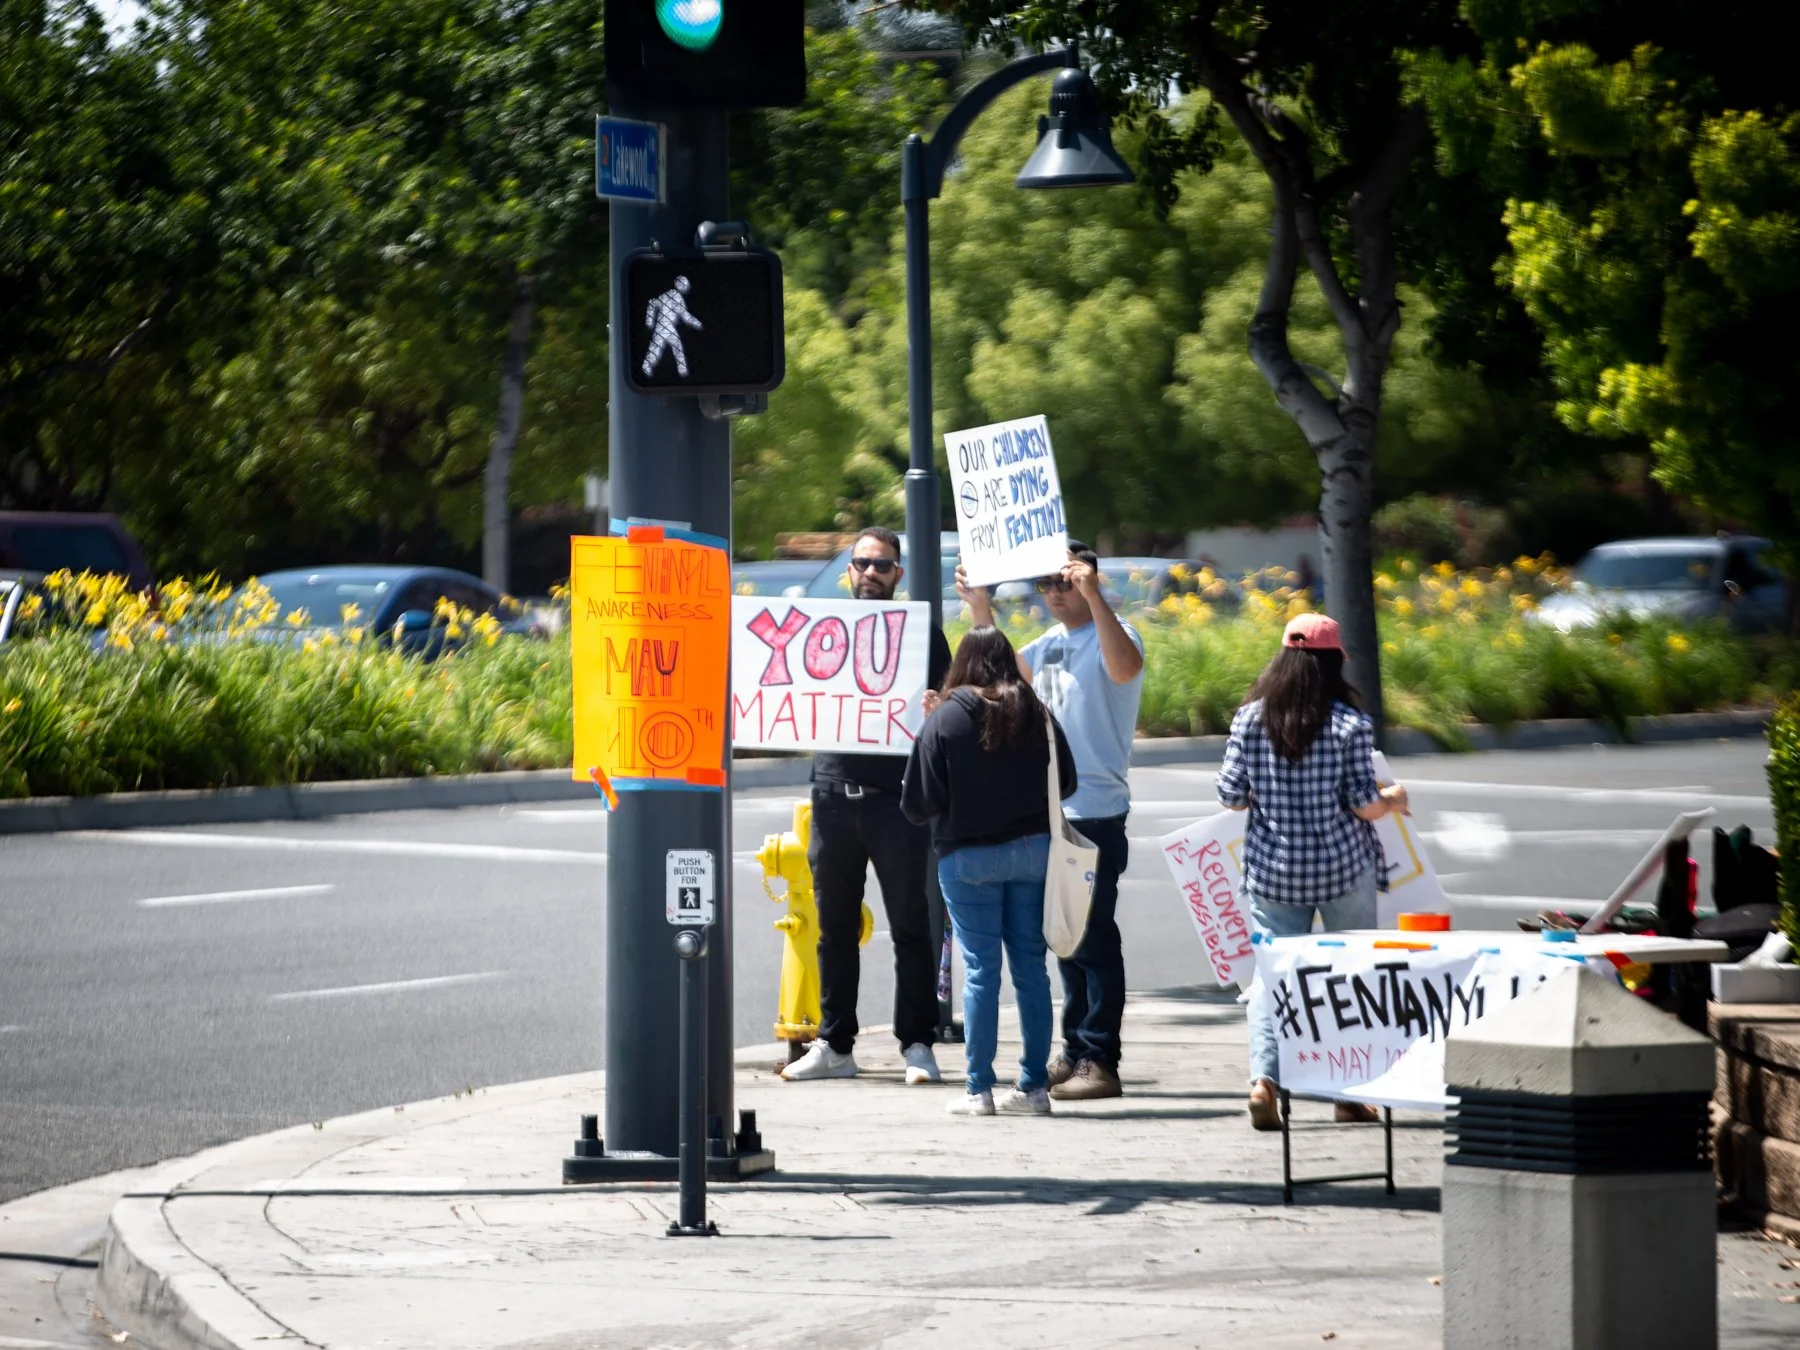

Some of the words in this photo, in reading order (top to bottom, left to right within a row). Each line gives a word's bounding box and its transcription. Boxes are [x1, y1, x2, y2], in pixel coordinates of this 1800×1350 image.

[612, 132, 647, 189] Lakewood
[960, 439, 988, 473] OUR
[992, 424, 1049, 468] CHILDREN
[984, 477, 1008, 513] ARE
[1009, 466, 1049, 507] DYING
[970, 515, 1002, 555] FROM
[1004, 495, 1066, 550] FENTANYL
[586, 597, 713, 621] AWARENESS
[605, 637, 679, 697] MAY
[746, 605, 908, 696] YOU
[732, 689, 916, 745] MATTER
[673, 867, 706, 875] BUTTON
[678, 858, 701, 866] PUSH
[1165, 838, 1190, 865] is
[681, 876, 697, 884] FOR
[1189, 838, 1254, 961] Recovery
